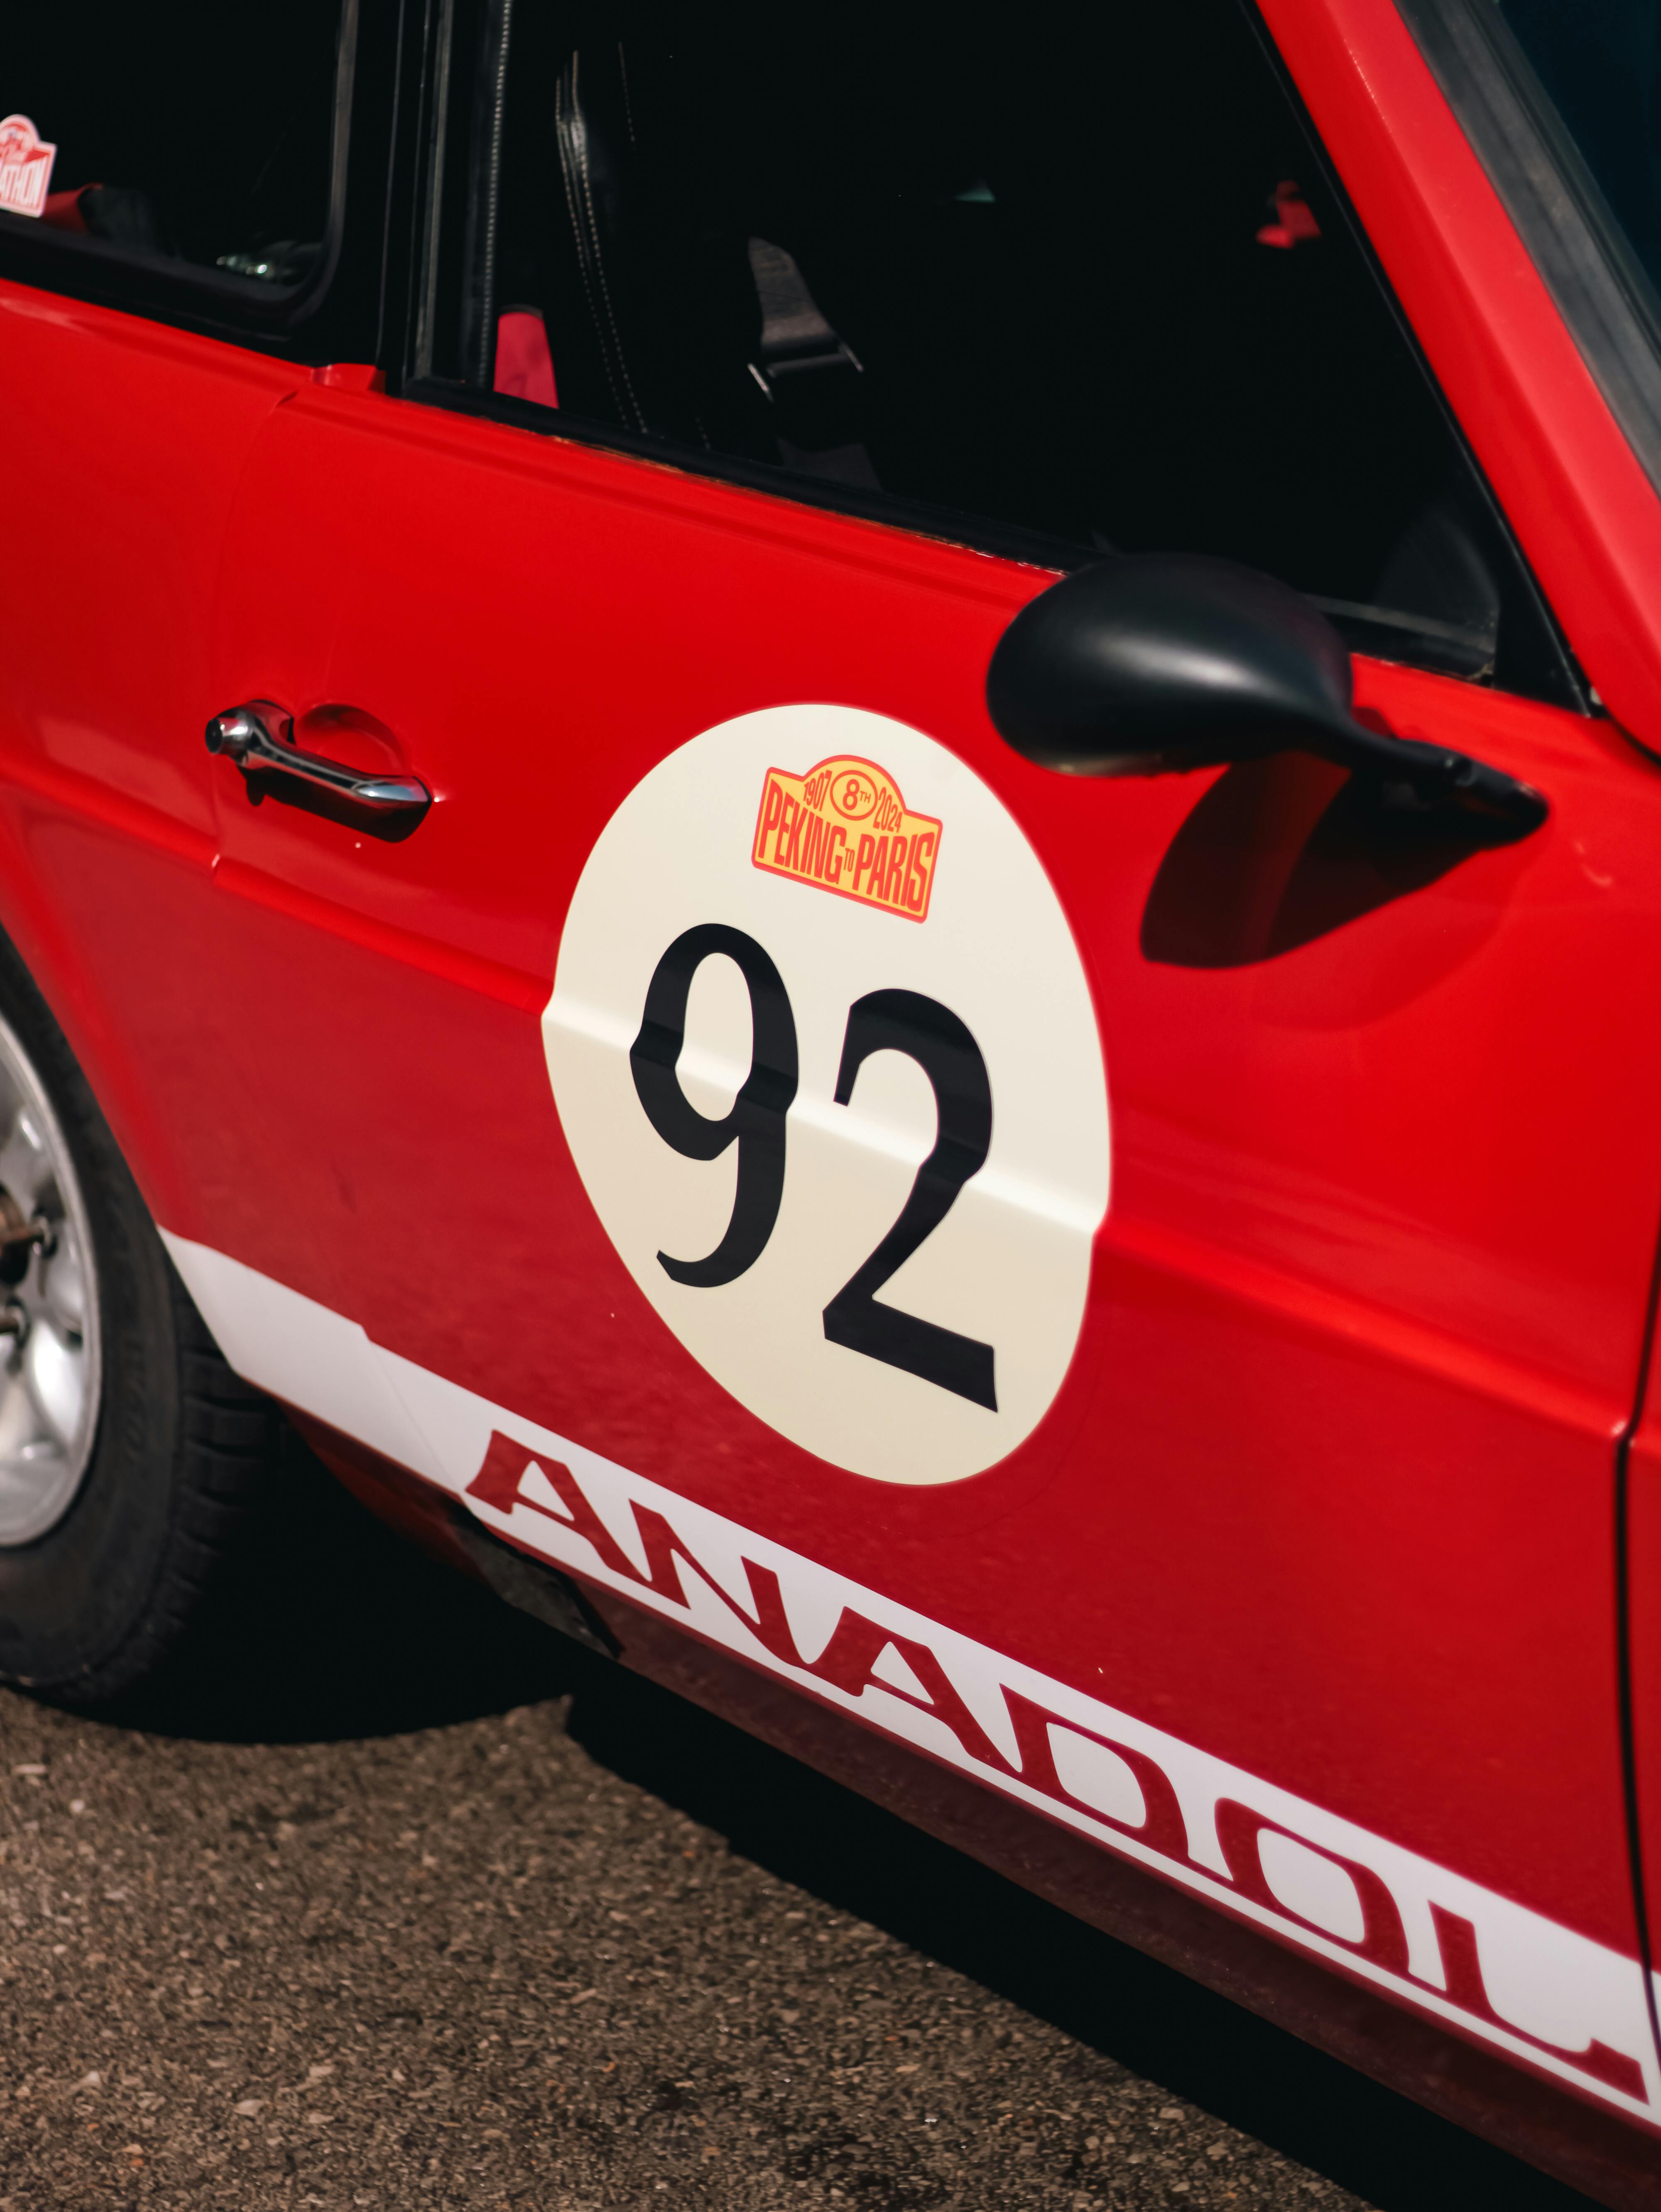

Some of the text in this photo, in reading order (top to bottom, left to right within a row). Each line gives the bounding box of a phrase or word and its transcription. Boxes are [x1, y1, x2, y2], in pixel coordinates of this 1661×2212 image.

[758, 778, 935, 912] PEKING TO PARIS
[803, 770, 902, 832] 1907 8TH 2024
[629, 923, 998, 1413] 92
[464, 1429, 1649, 2104] ANADOL
